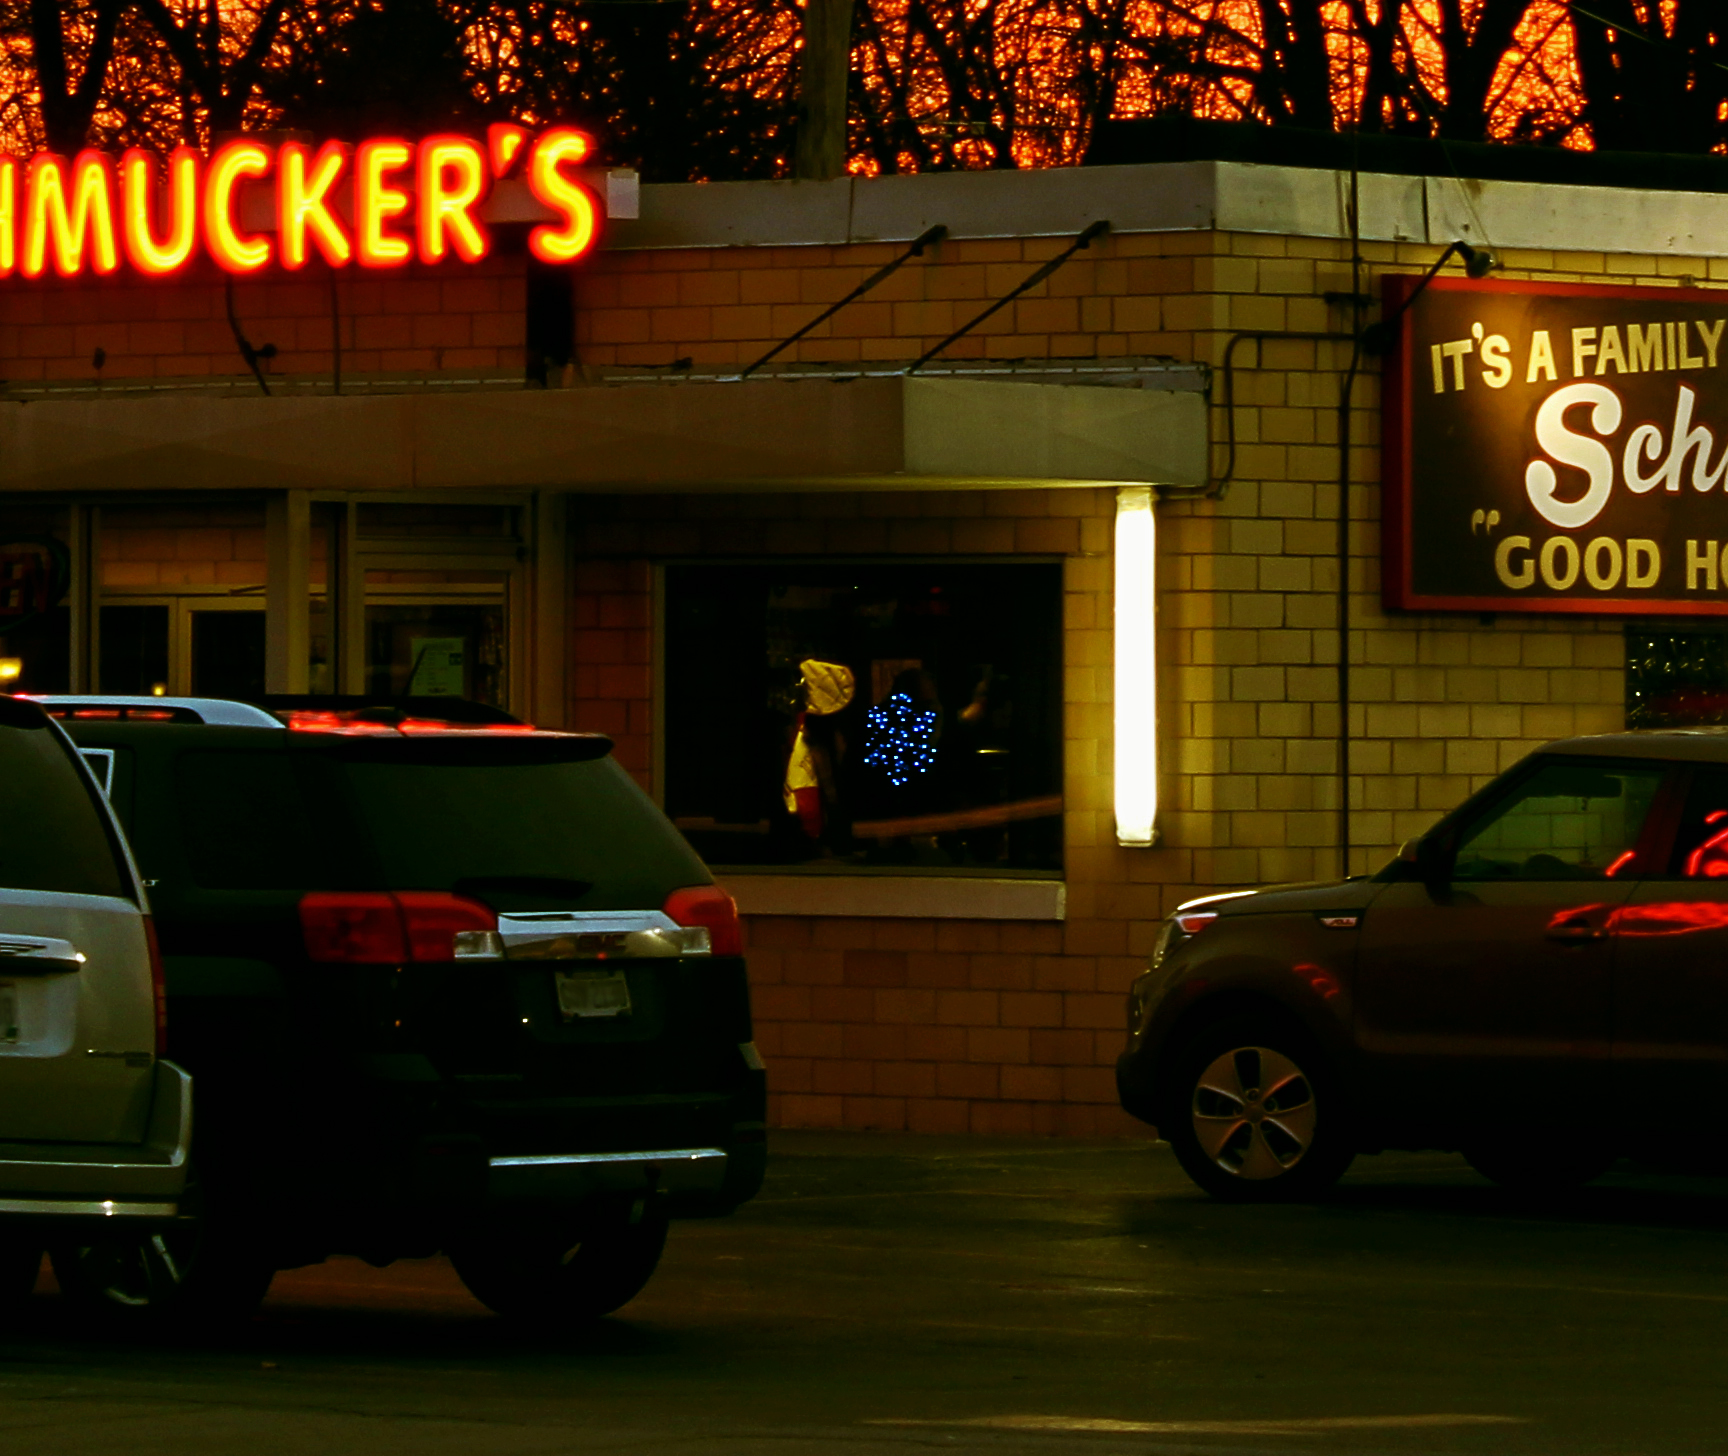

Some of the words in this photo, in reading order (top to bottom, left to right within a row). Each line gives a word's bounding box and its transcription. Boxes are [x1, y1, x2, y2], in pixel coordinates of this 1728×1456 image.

[1430, 321, 1513, 394] IT'S
[1526, 330, 1558, 382] A
[1572, 319, 1726, 377] FAMILY
